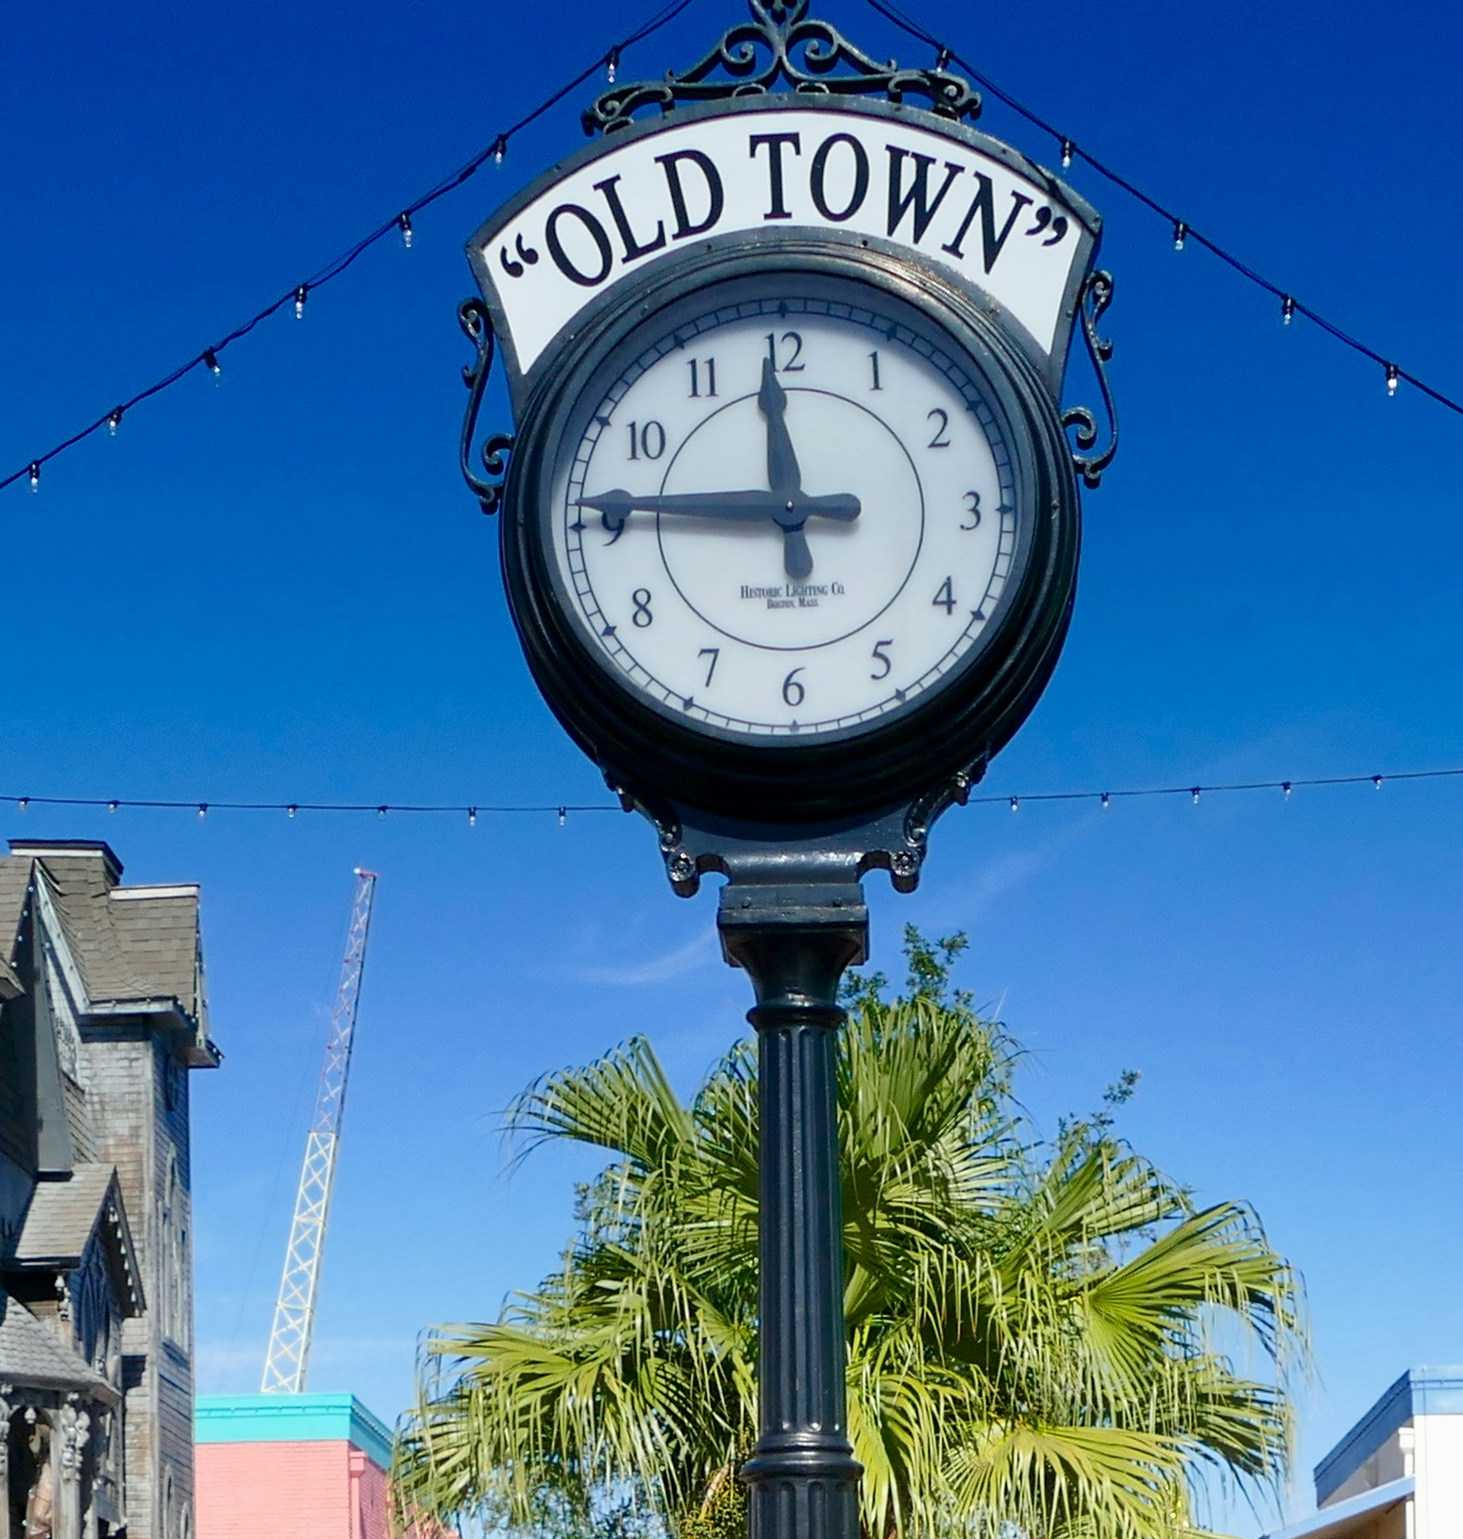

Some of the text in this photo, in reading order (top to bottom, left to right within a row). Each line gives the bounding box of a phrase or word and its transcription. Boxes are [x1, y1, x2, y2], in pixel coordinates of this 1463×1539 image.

[764, 331, 806, 372] 12
[867, 351, 884, 391] 1
[686, 357, 719, 398] 11
[626, 420, 666, 460] 10
[926, 408, 951, 449] 2
[959, 491, 983, 531] 3
[630, 588, 654, 628] 8
[932, 575, 957, 615] 4
[696, 647, 722, 688] 7
[869, 639, 895, 682] 5
[782, 665, 805, 707] 6
